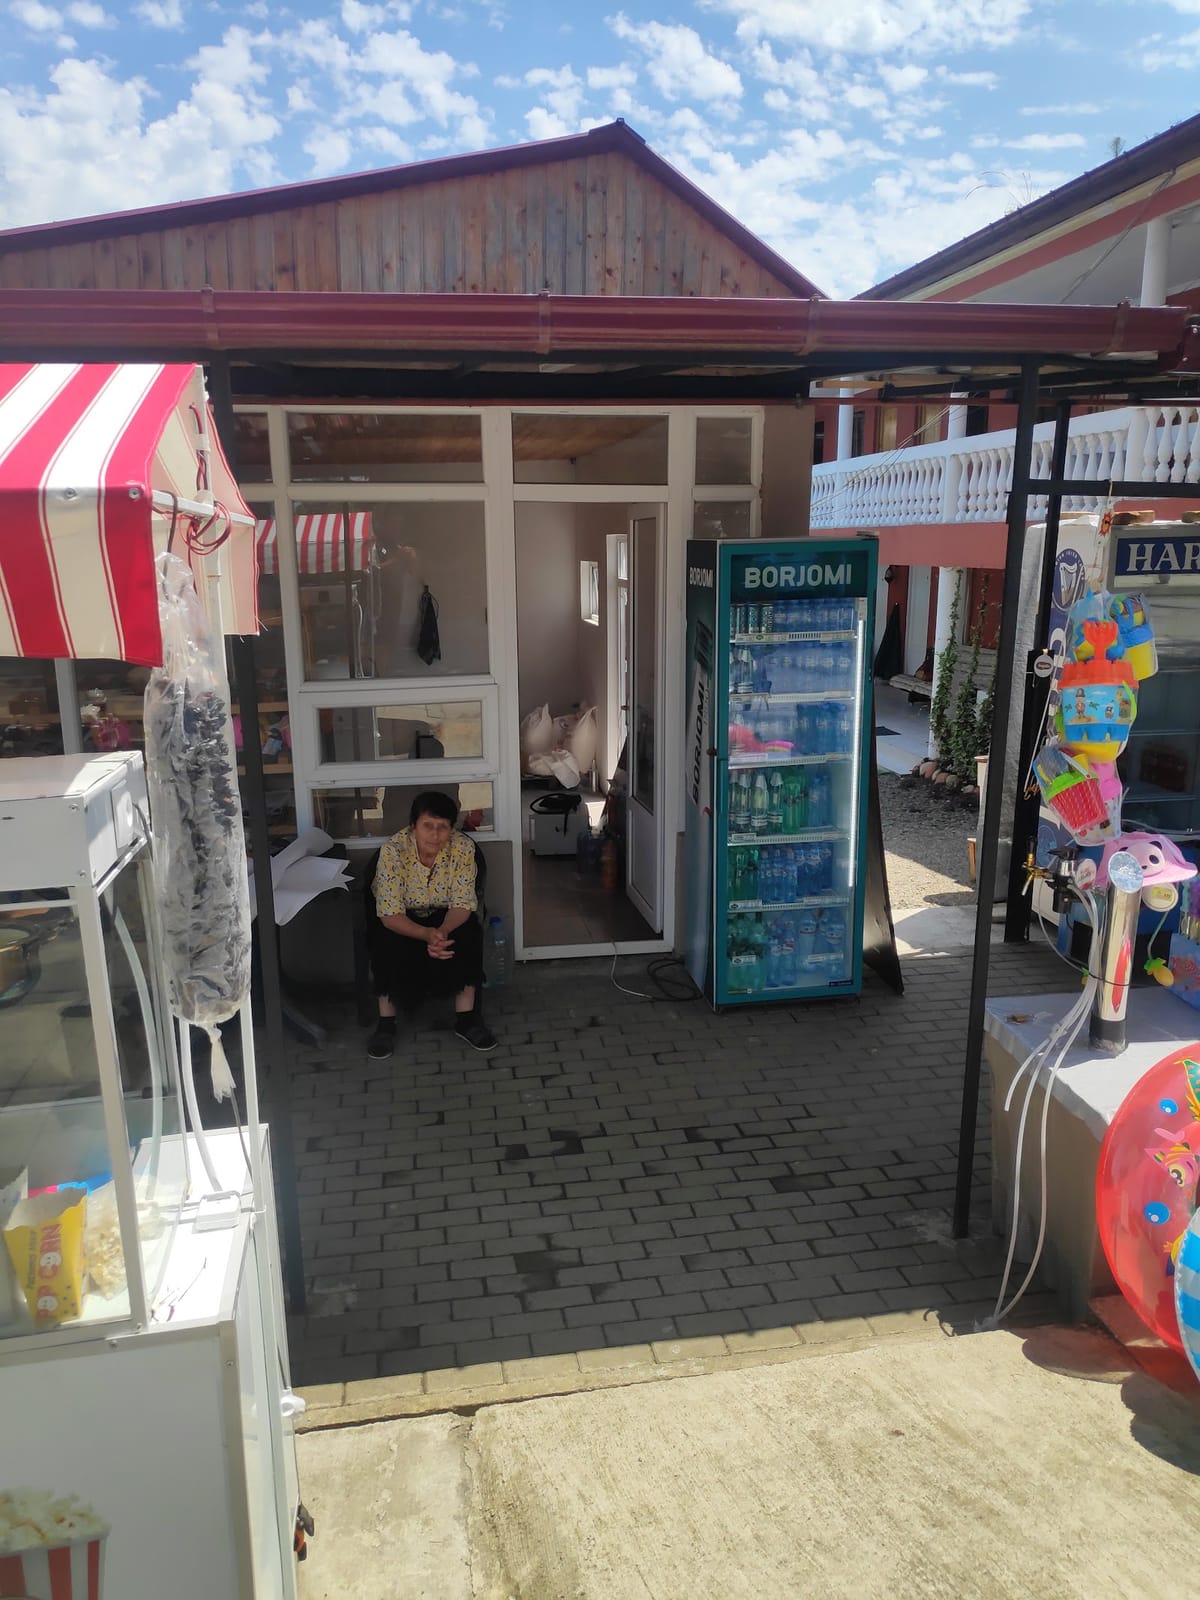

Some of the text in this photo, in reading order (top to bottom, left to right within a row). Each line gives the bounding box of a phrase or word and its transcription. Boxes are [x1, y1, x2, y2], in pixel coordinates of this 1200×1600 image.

[689, 567, 714, 588] BORJOMI
[744, 564, 852, 589] BORJOMI
[692, 681, 705, 805] BORJOMI
